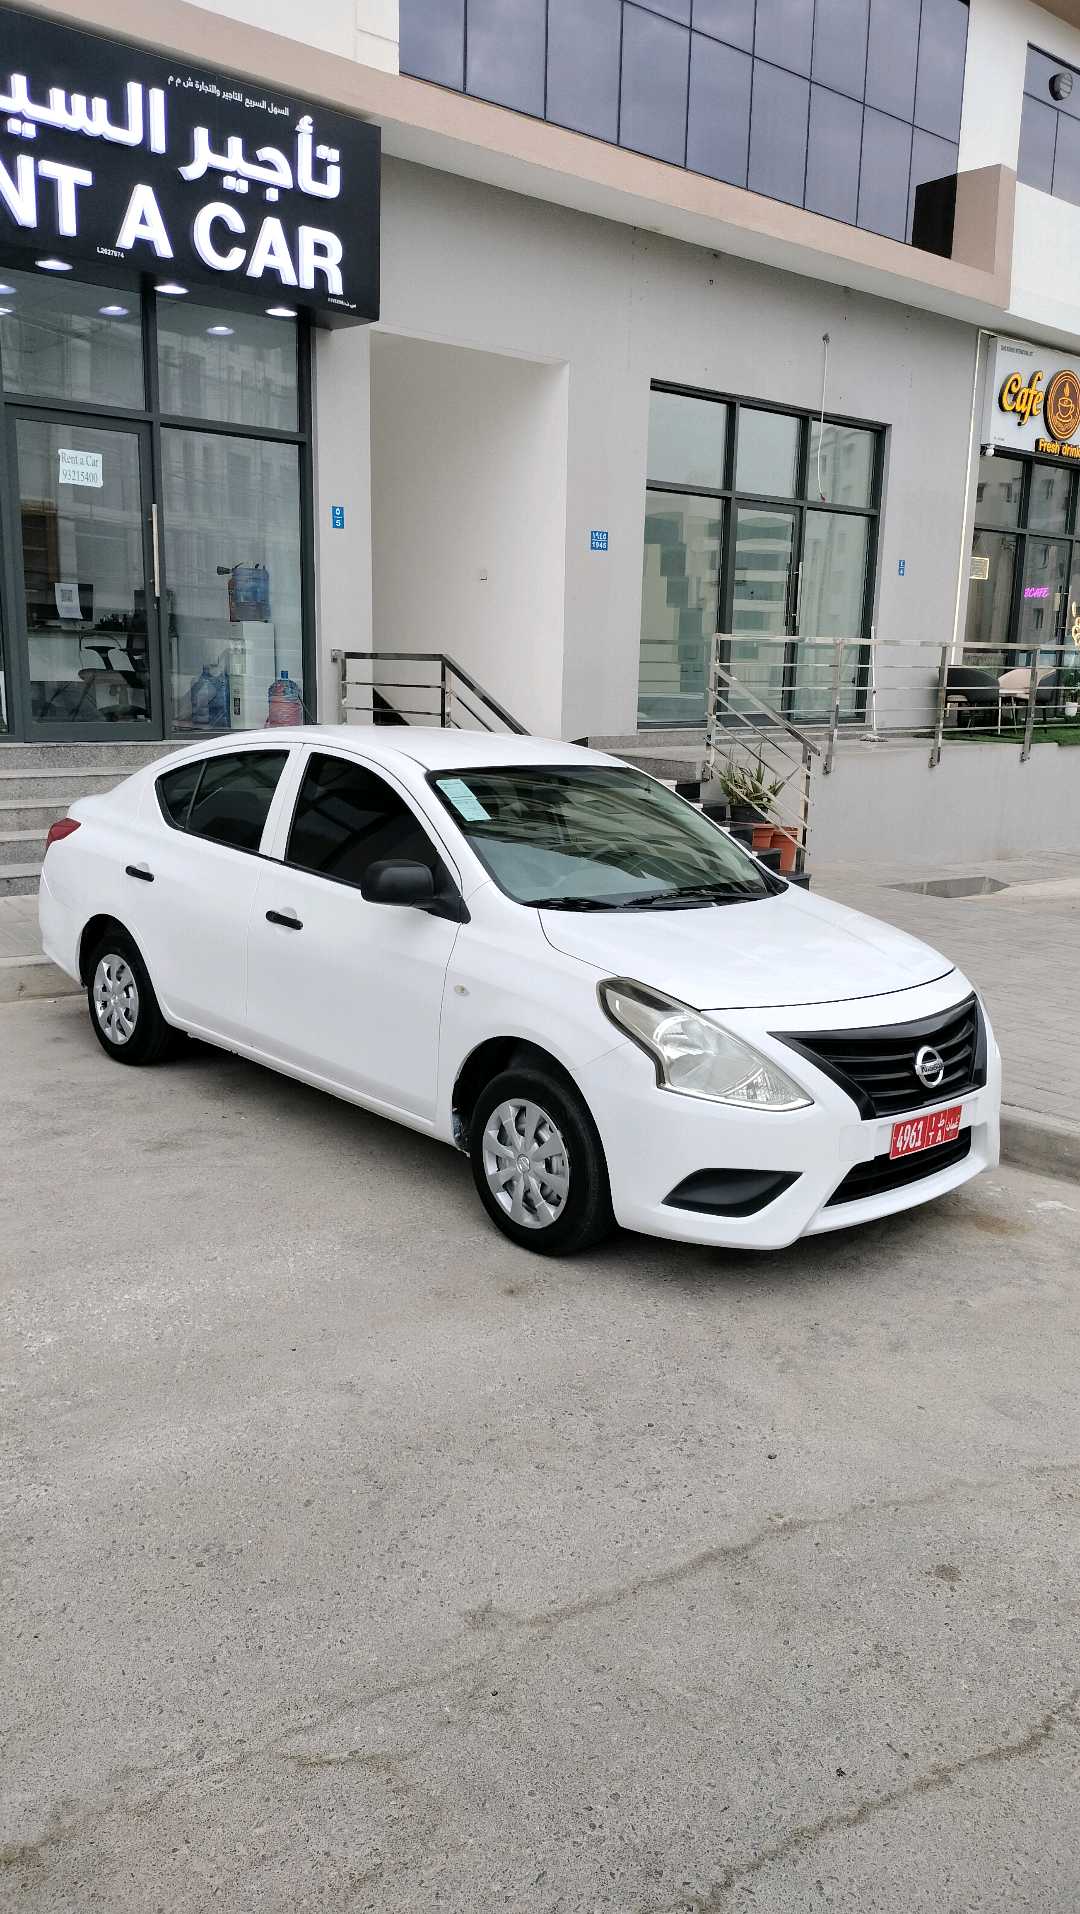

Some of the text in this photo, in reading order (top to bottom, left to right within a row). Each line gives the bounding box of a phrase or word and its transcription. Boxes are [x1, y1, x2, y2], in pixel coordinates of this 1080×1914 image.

[178, 115, 341, 201] تأجير
[116, 183, 175, 259] A
[193, 201, 345, 296] CAR
[1000, 370, 1044, 427] Cafe
[61, 453, 78, 465] Rent
[86, 455, 98, 467] Car
[1039, 438, 1060, 456] Fresh
[896, 1120, 924, 1152] 4961
